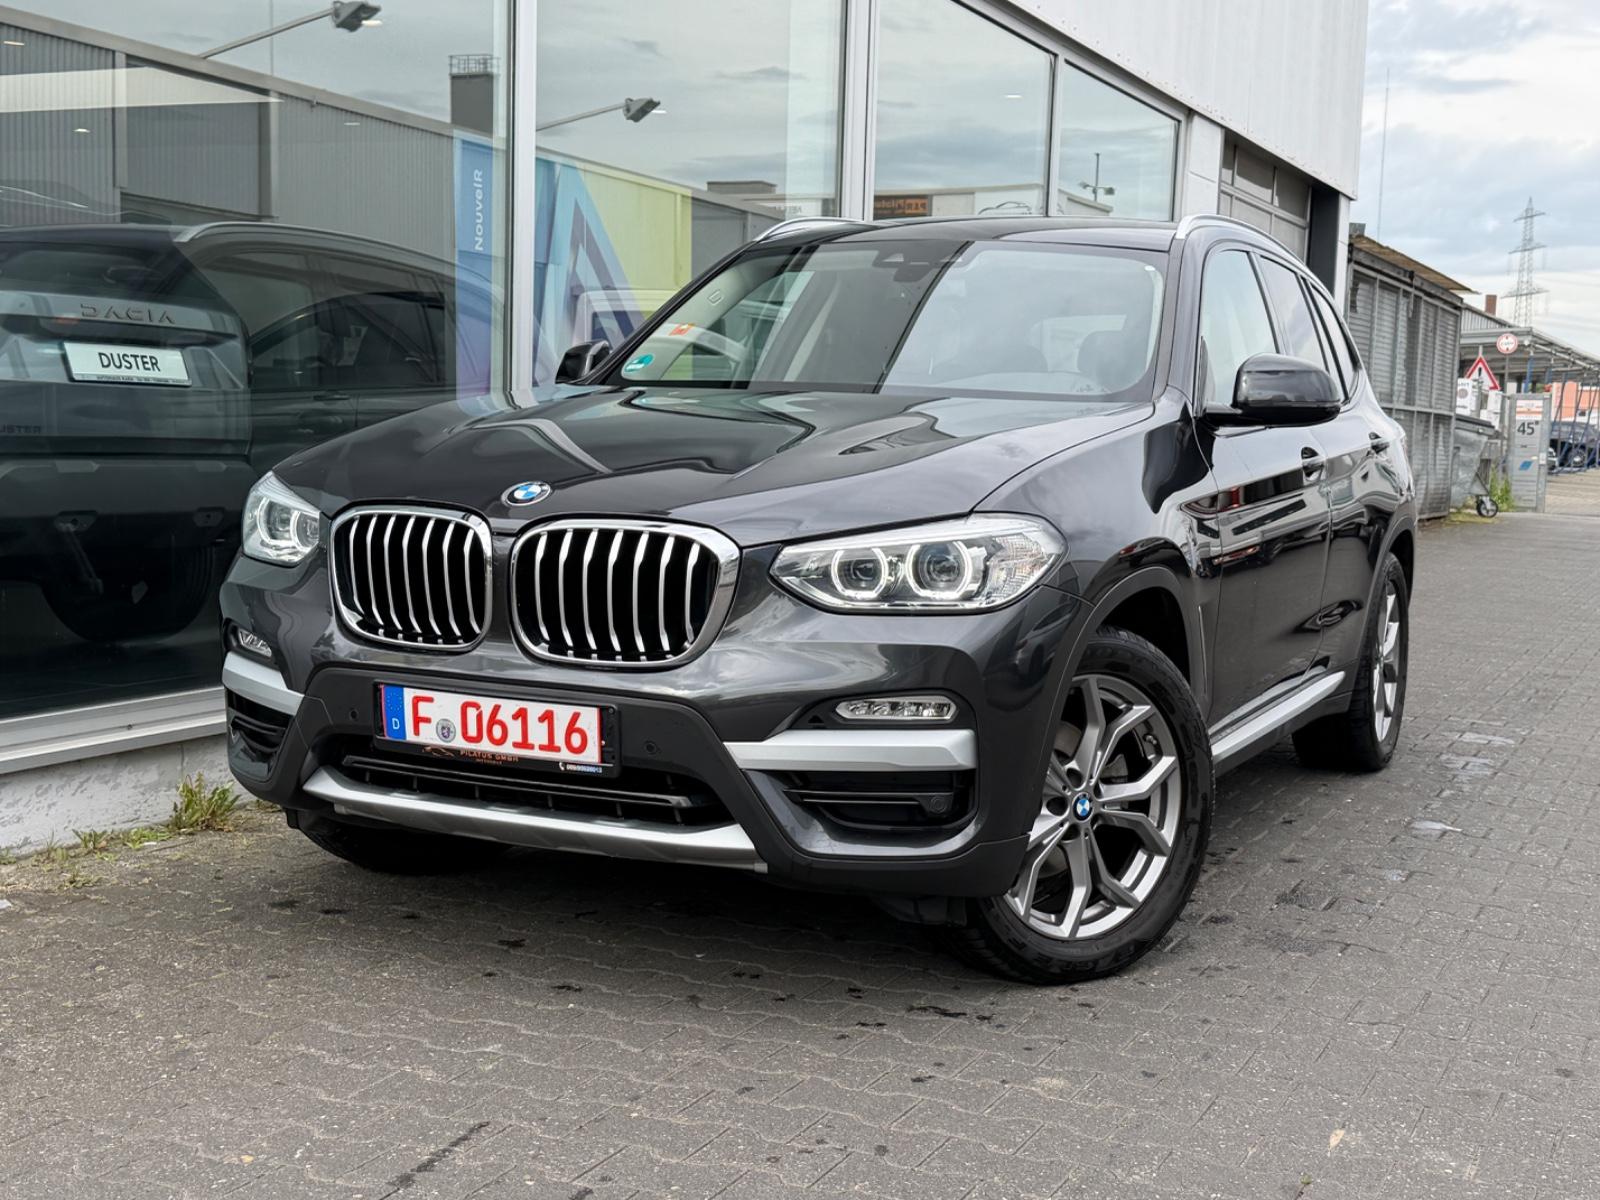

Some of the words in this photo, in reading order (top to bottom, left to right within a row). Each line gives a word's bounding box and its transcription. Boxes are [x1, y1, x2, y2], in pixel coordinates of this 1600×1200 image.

[80, 303, 176, 324] DACIA
[98, 352, 161, 372] DUSTER
[391, 717, 400, 730] D
[411, 695, 434, 737] F
[460, 700, 589, 755] 06116
